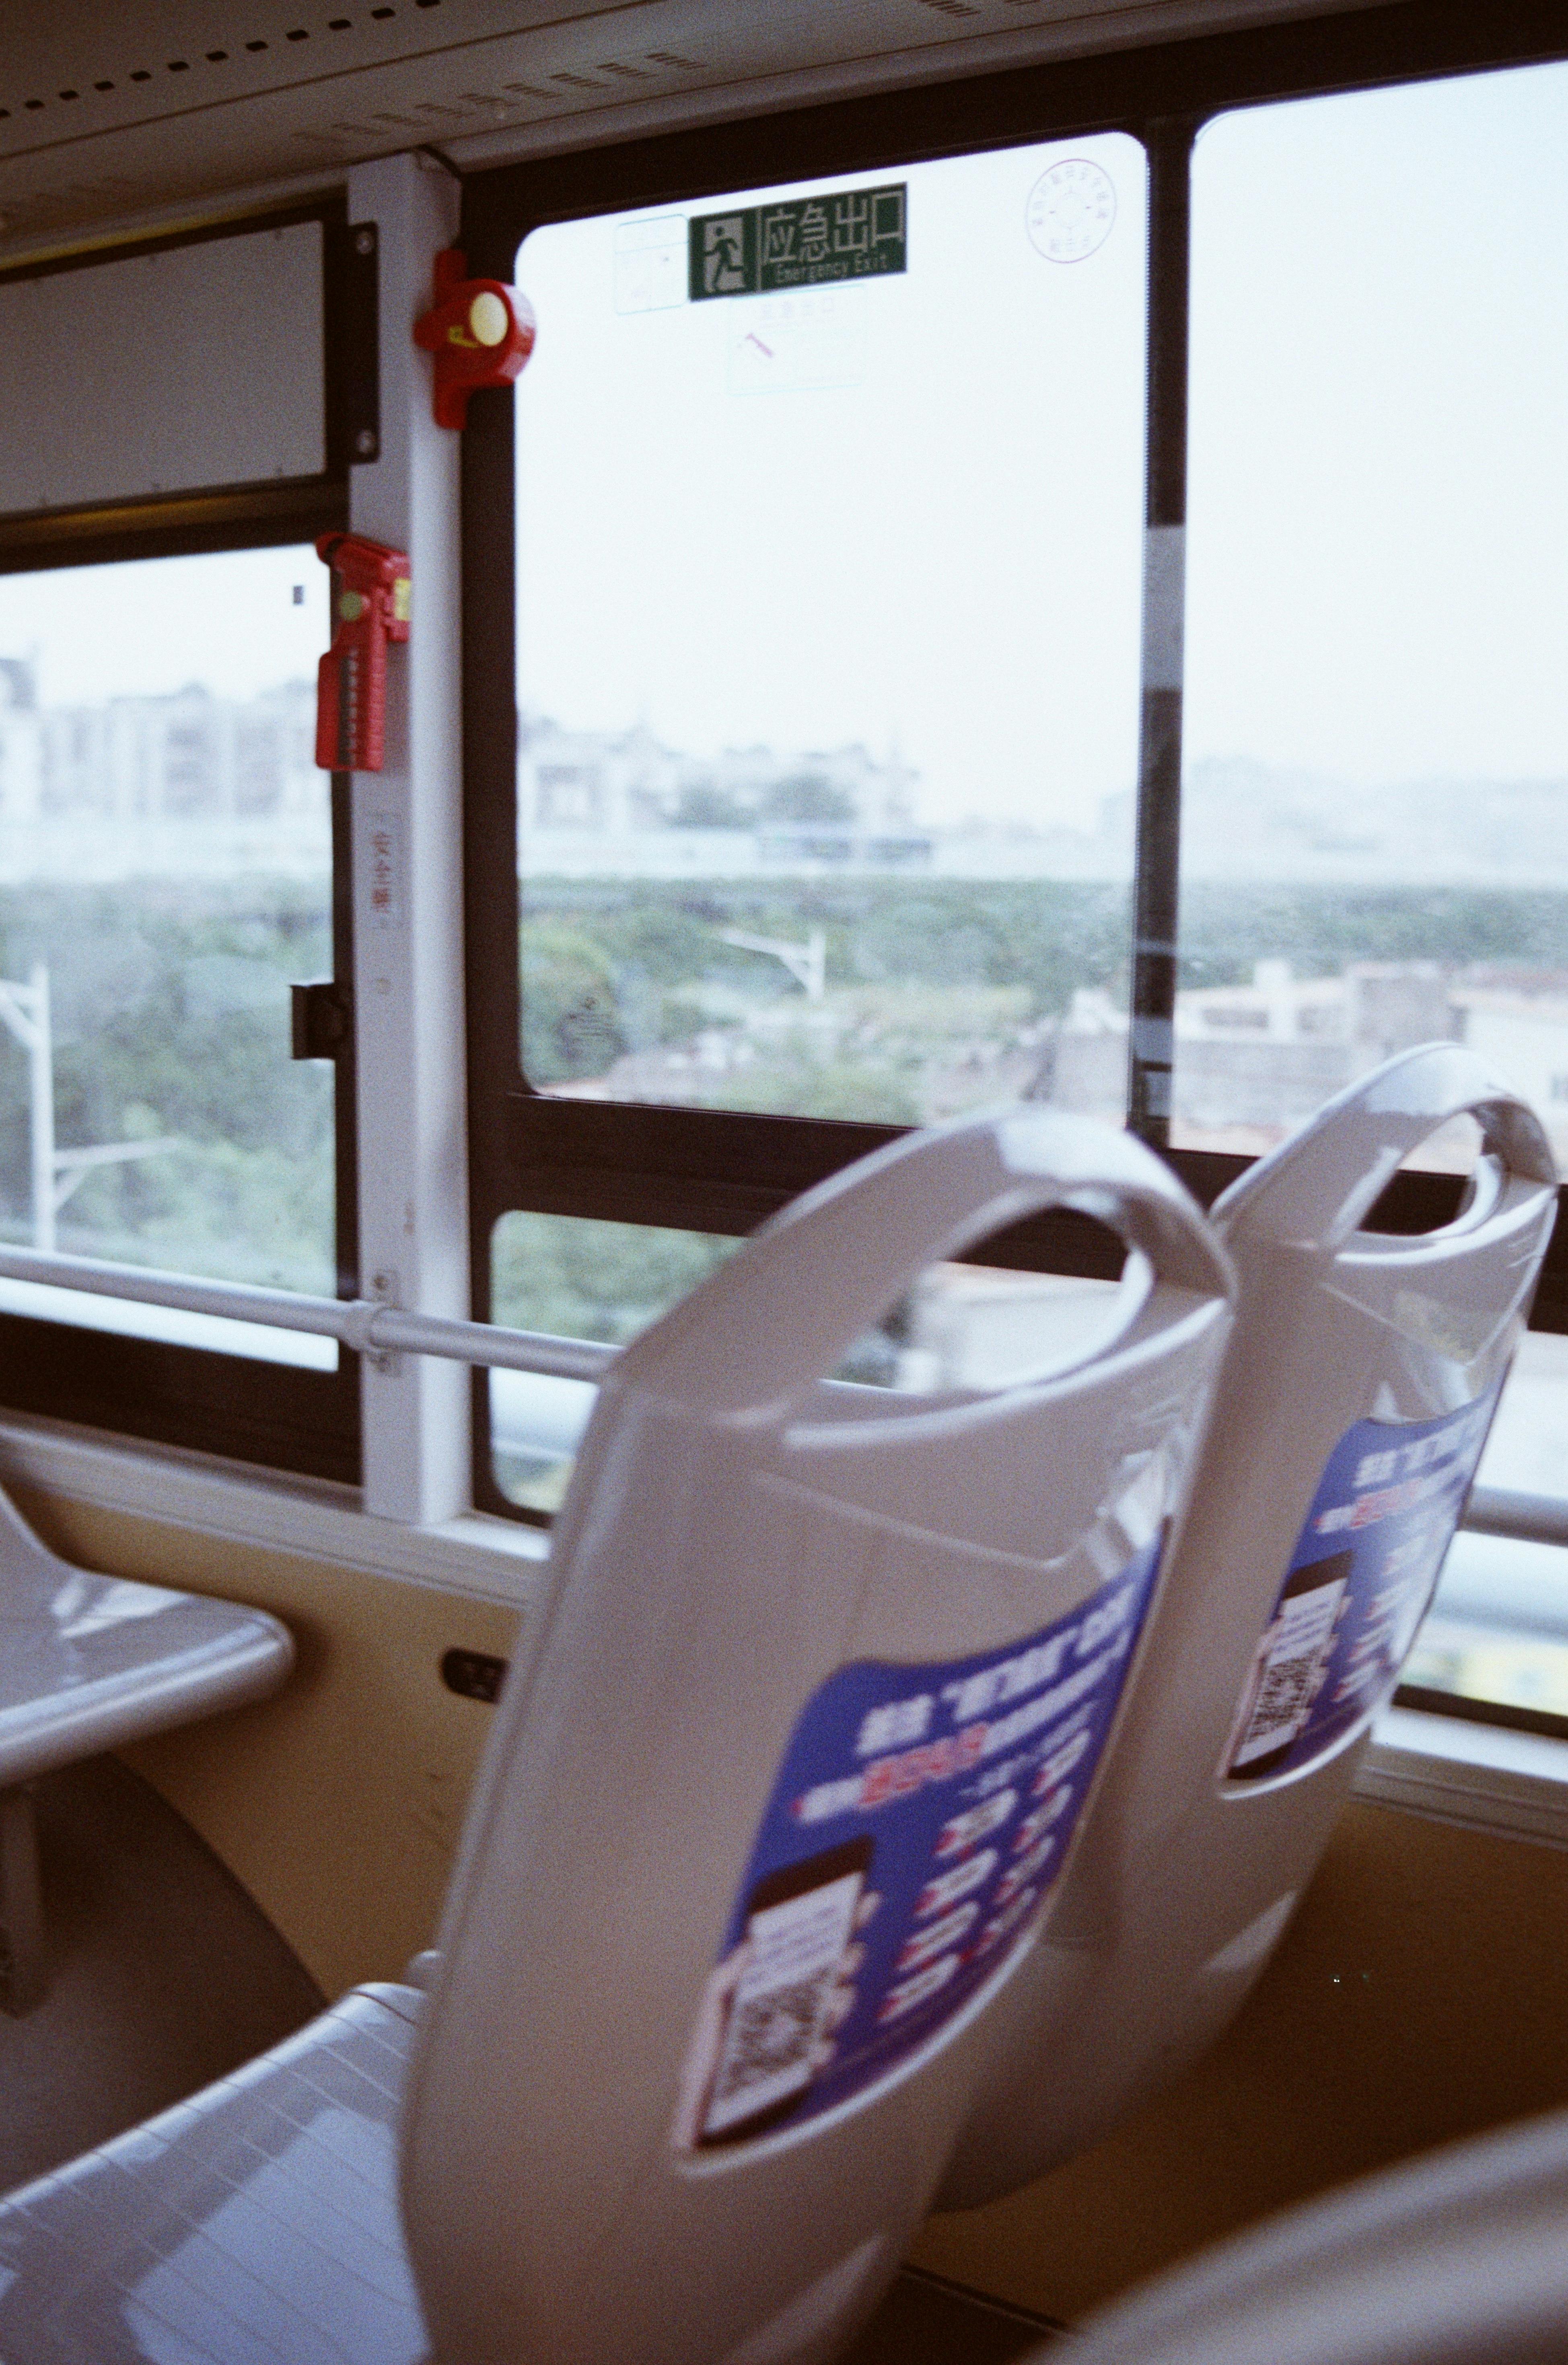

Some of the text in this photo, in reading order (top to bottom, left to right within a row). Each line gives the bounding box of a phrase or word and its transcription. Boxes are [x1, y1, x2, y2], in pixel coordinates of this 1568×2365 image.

[764, 191, 904, 264] 应急出口
[776, 251, 886, 283] Emergency Exit
